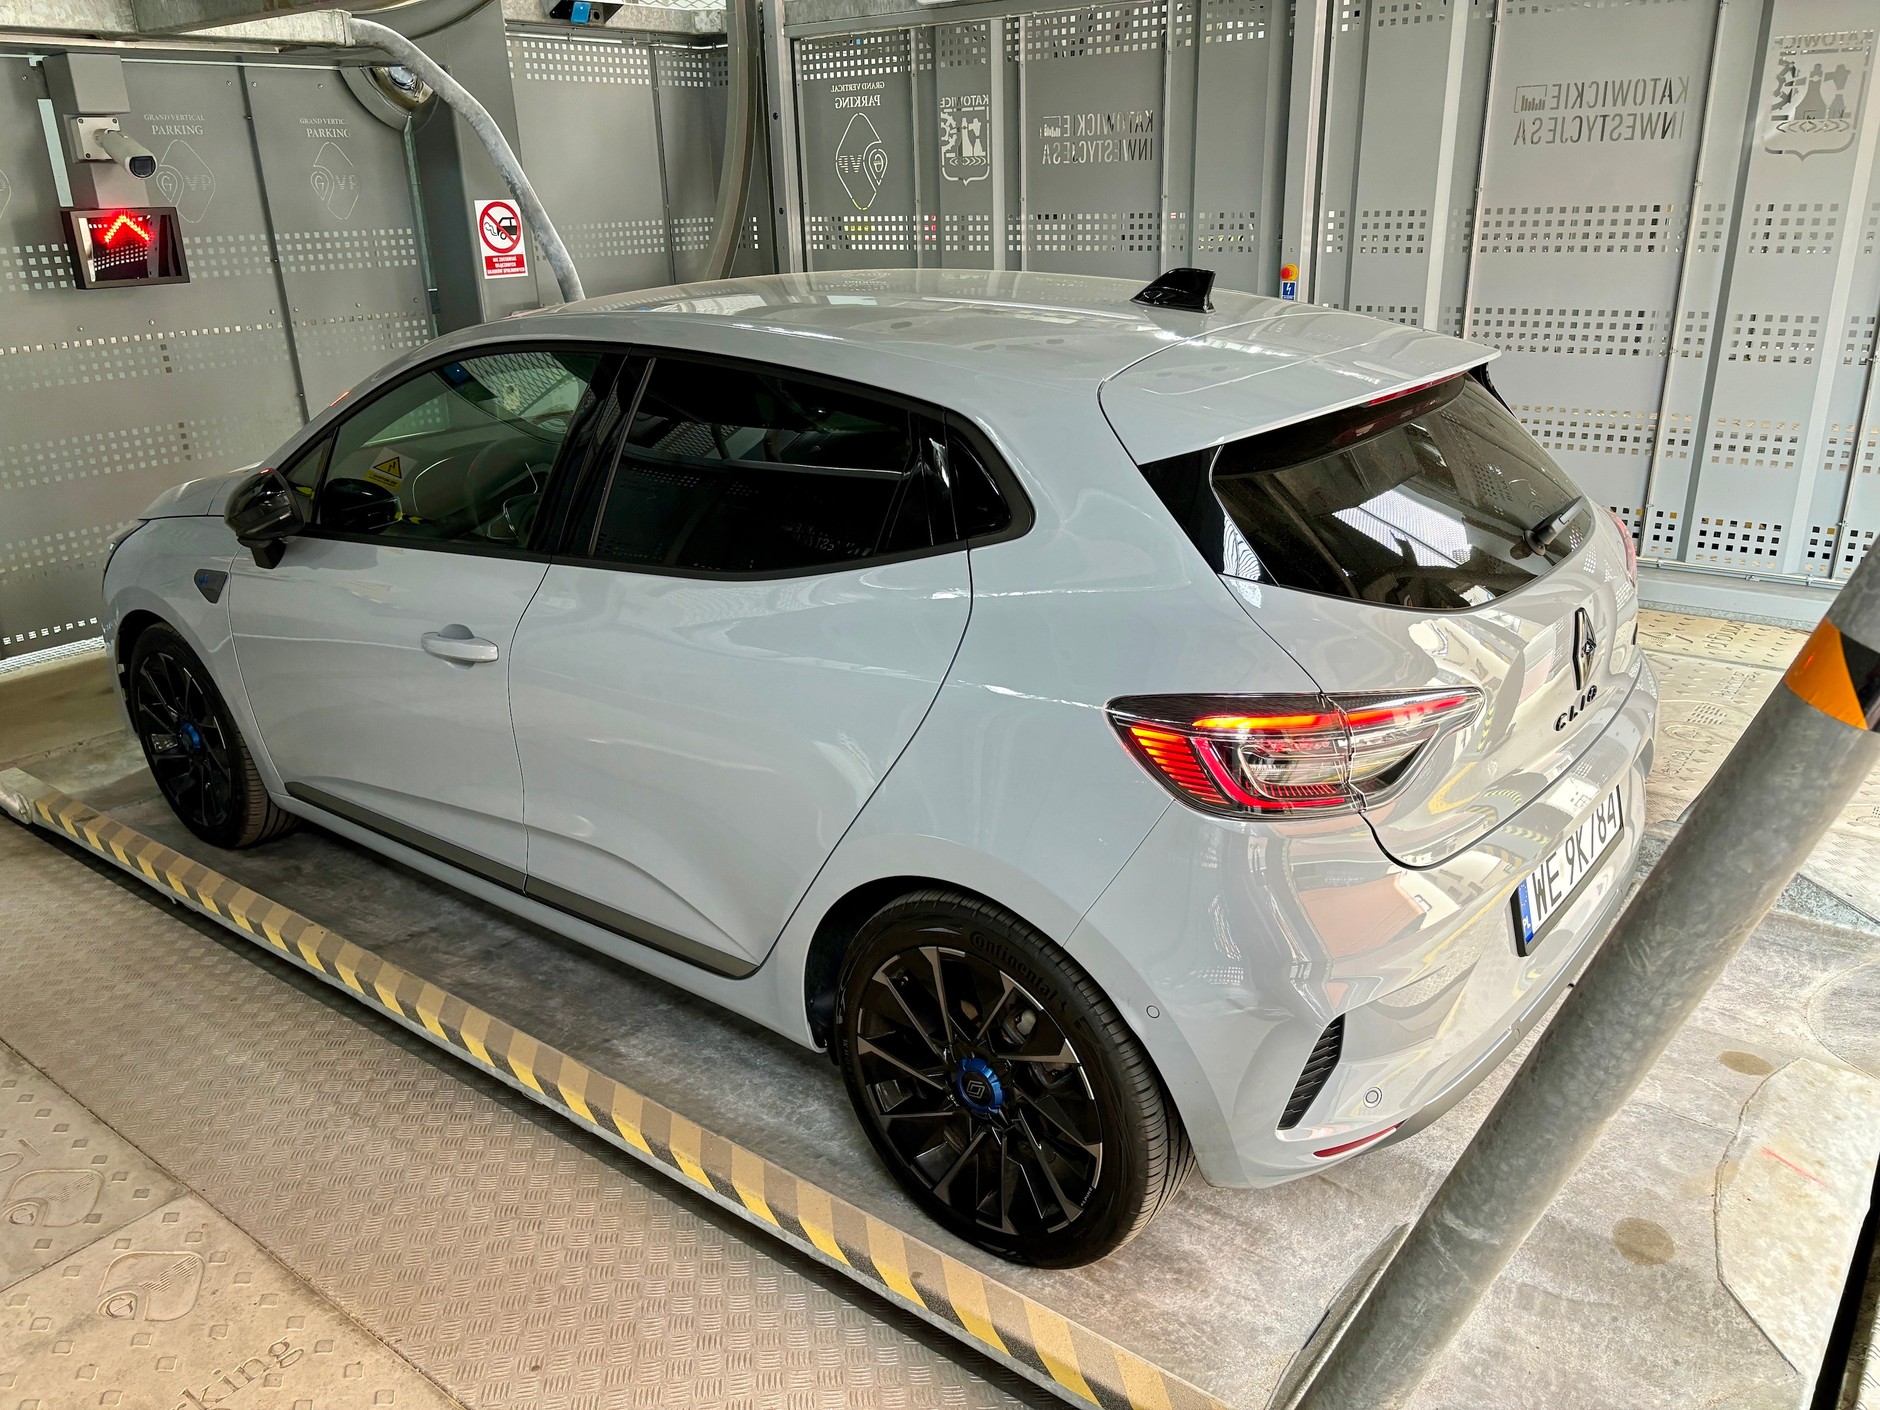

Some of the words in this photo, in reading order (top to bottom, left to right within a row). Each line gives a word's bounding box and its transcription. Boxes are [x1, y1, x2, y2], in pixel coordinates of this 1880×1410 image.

[143, 113, 170, 121] GRAND
[170, 113, 205, 121] VERTICAL
[299, 117, 322, 125] GRAND
[151, 124, 204, 136] PARKING
[306, 128, 351, 138] PARKING
[1555, 684, 1598, 731] CLIO
[1532, 851, 1562, 922] WE
[1522, 917, 1531, 931] PL
[969, 930, 1058, 1000] Continental
